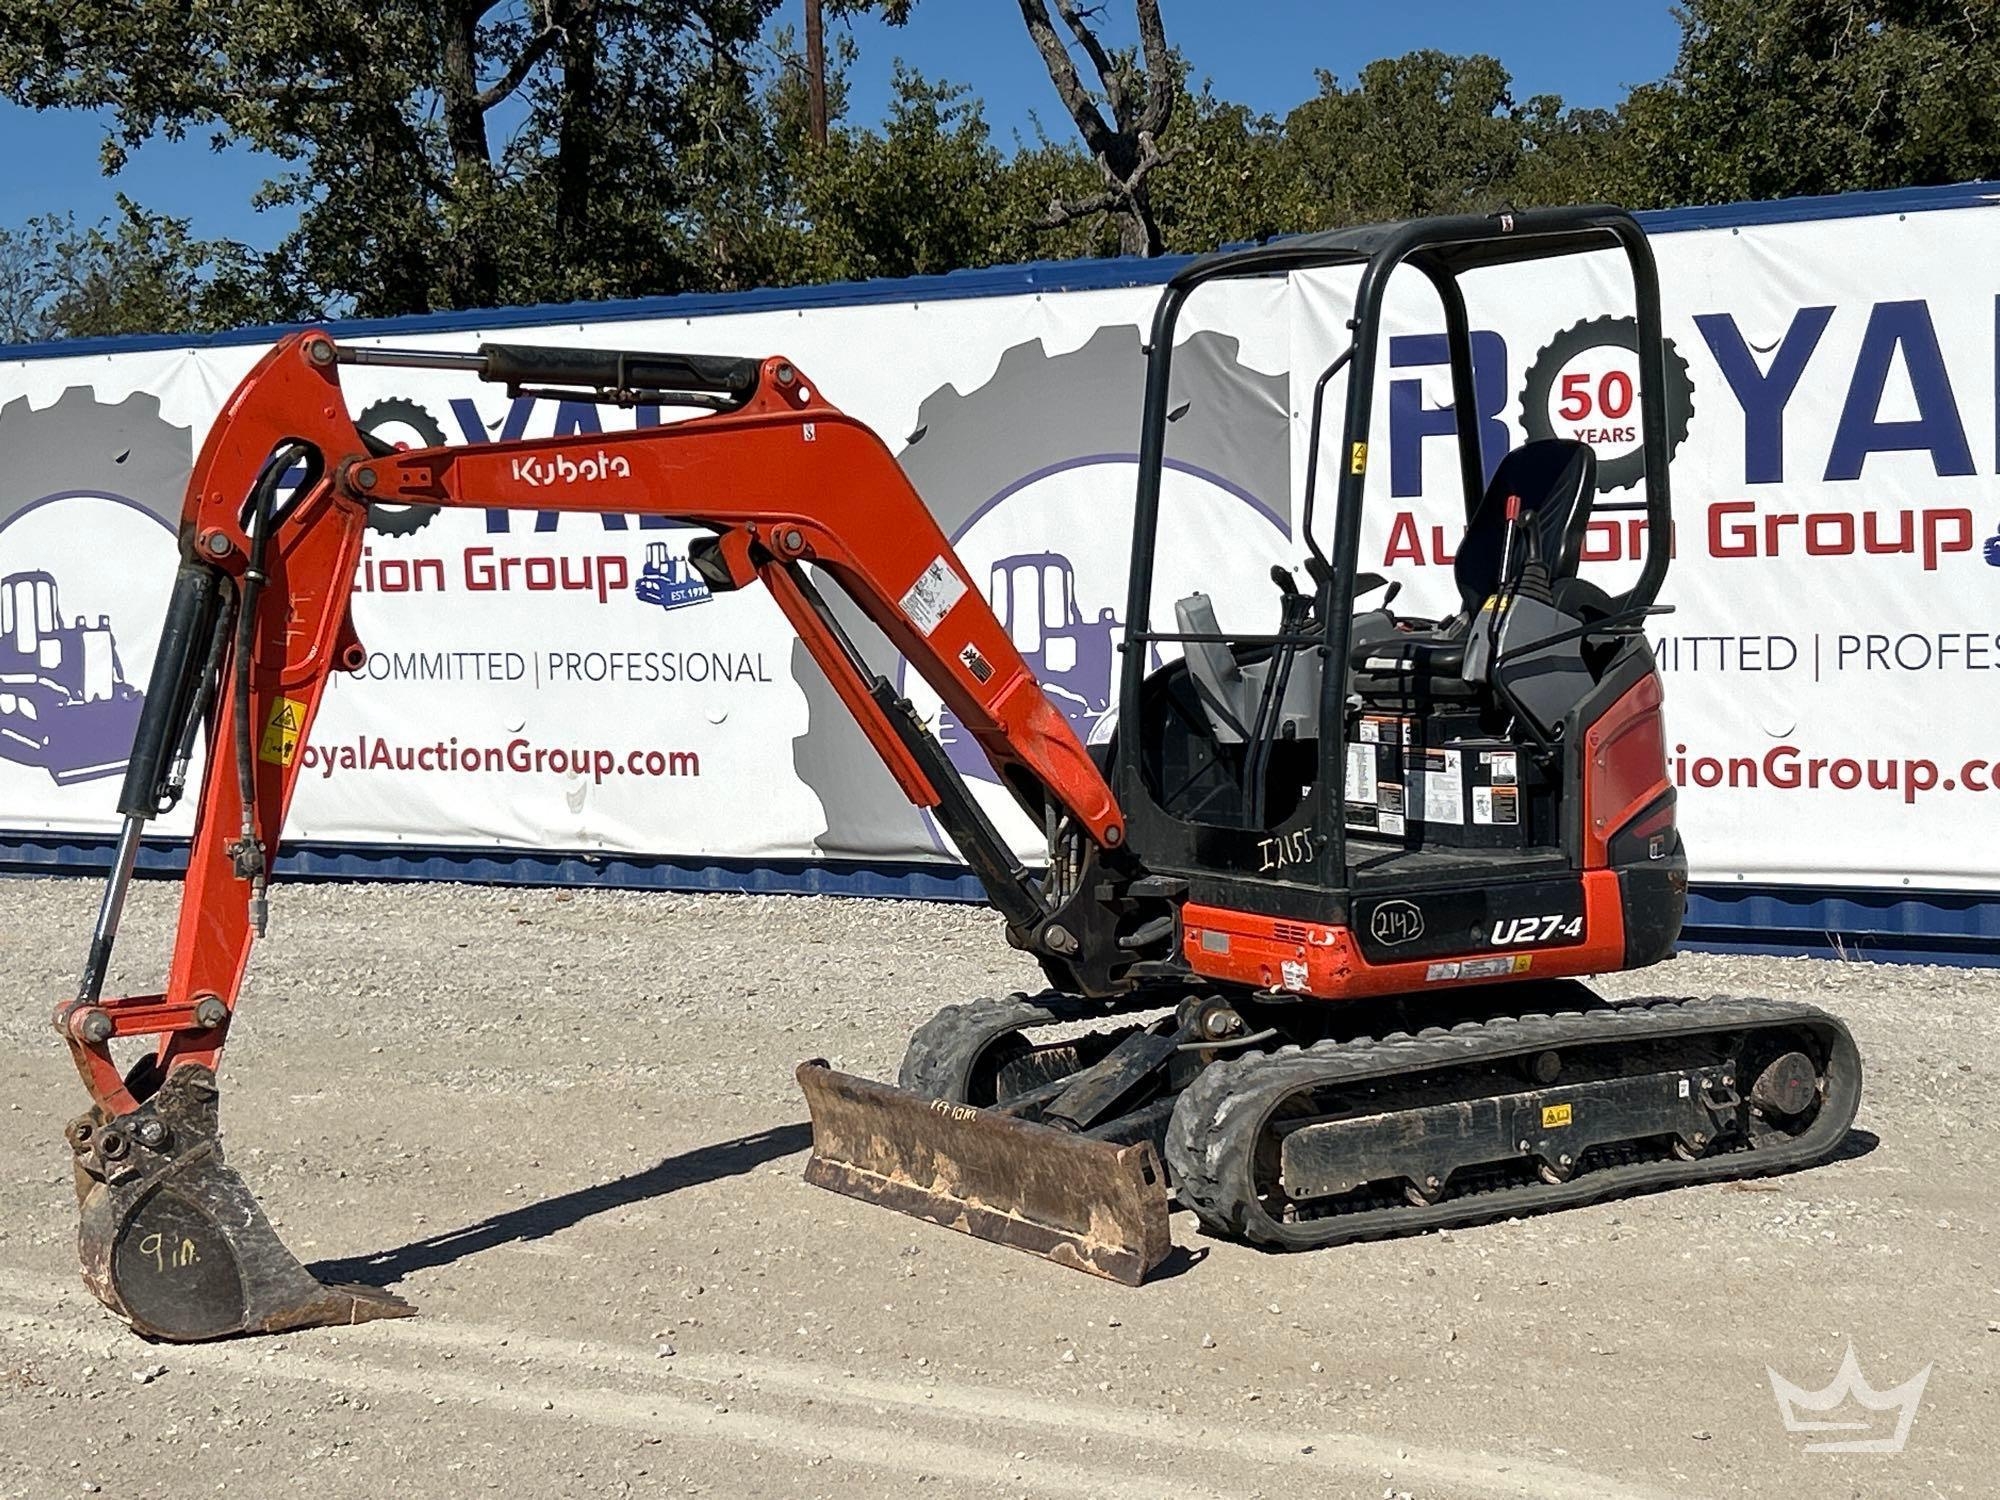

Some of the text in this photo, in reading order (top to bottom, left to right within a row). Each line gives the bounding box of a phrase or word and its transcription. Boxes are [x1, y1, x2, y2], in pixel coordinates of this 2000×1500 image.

[1558, 370, 1634, 421] 50
[1574, 427, 1636, 444] YEARS
[512, 451, 631, 487] Kubota
[1707, 501, 1974, 570] Group
[463, 546, 629, 603] Group
[548, 651, 773, 683] PROFESSIONAL
[302, 735, 701, 785] oyalAuctionGroup.com
[1668, 743, 2000, 804] ionGroup.c
[1490, 914, 1583, 945] U27-4
